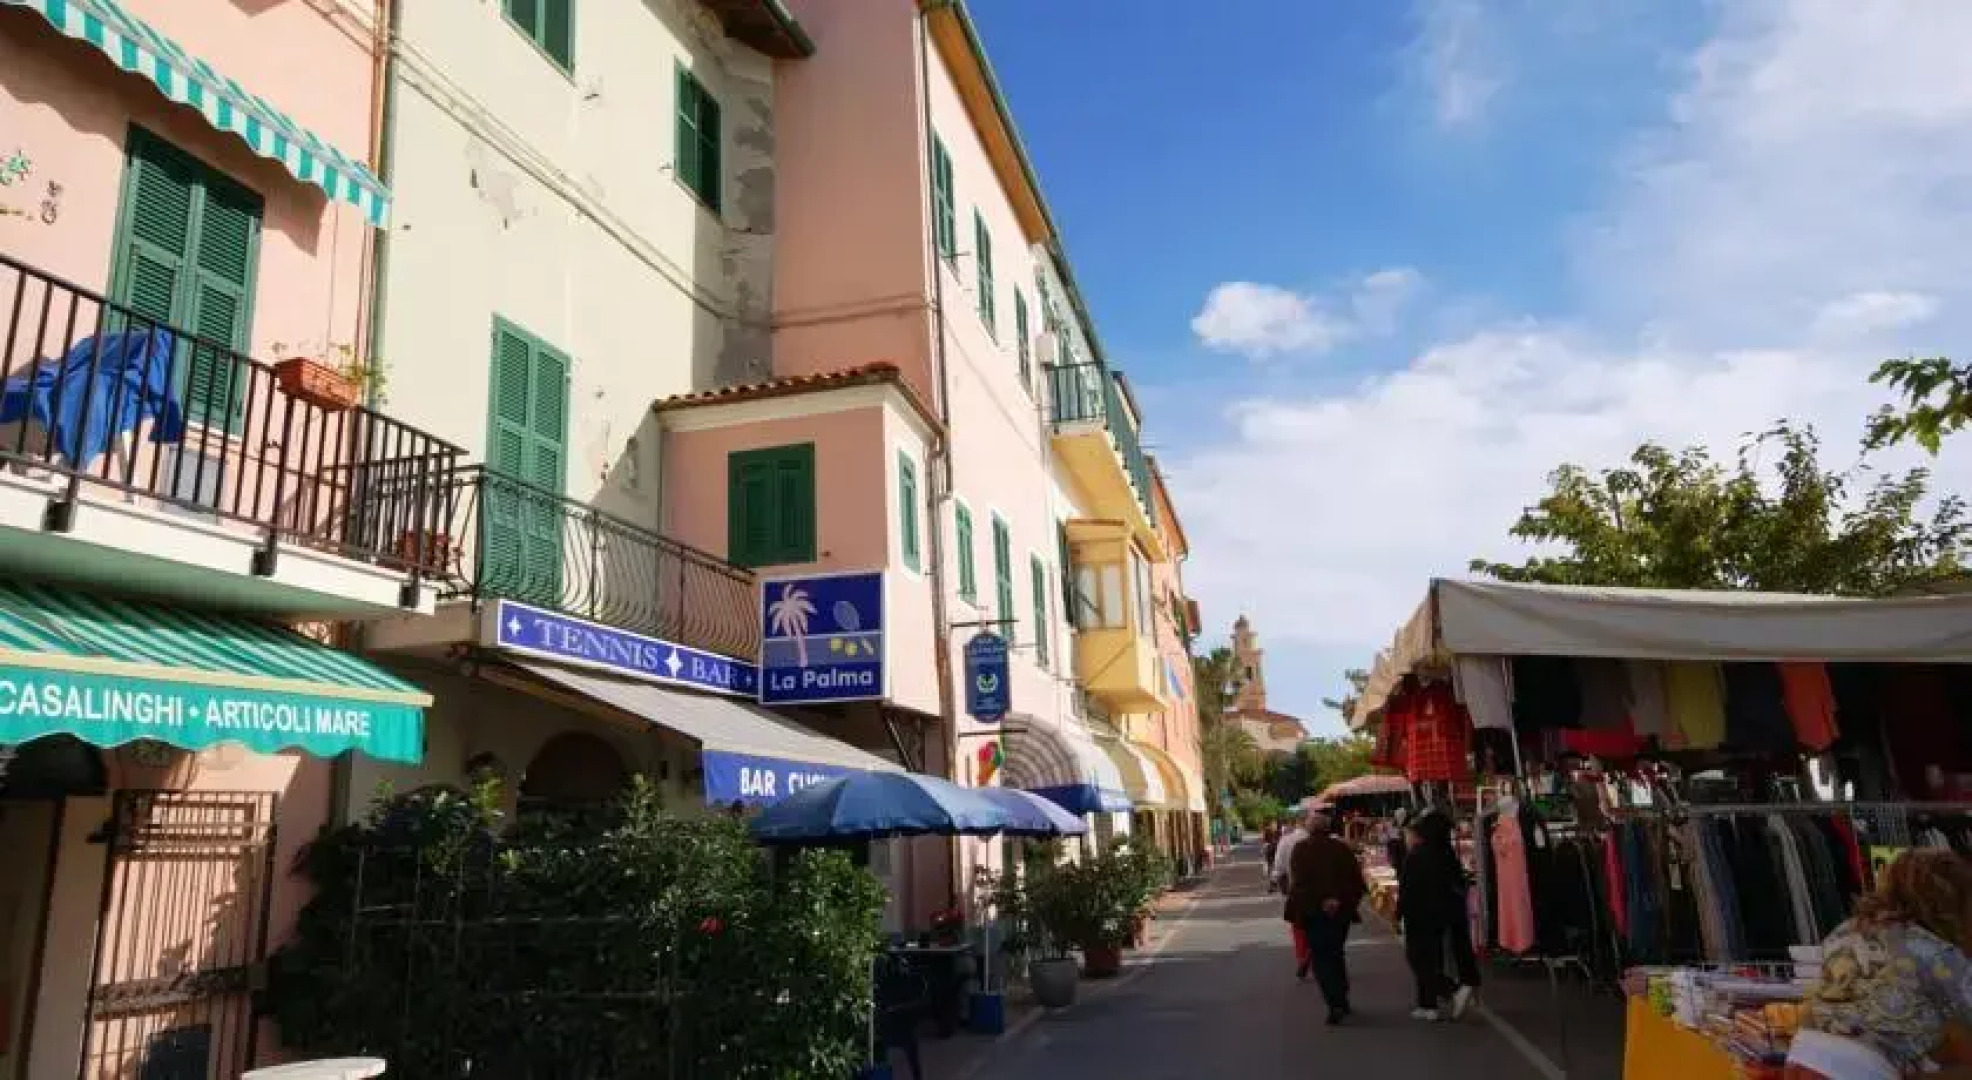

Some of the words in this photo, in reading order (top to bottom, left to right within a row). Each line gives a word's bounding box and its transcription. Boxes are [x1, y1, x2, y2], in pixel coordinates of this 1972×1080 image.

[533, 618, 659, 671] TENNIS
[692, 656, 738, 688] BAR
[771, 670, 796, 691] La
[803, 666, 874, 689] Palma
[0, 680, 184, 727] CASALINGHI
[206, 697, 311, 733] ARTICOLI
[316, 706, 372, 737] MARE
[740, 767, 776, 797] BAR
